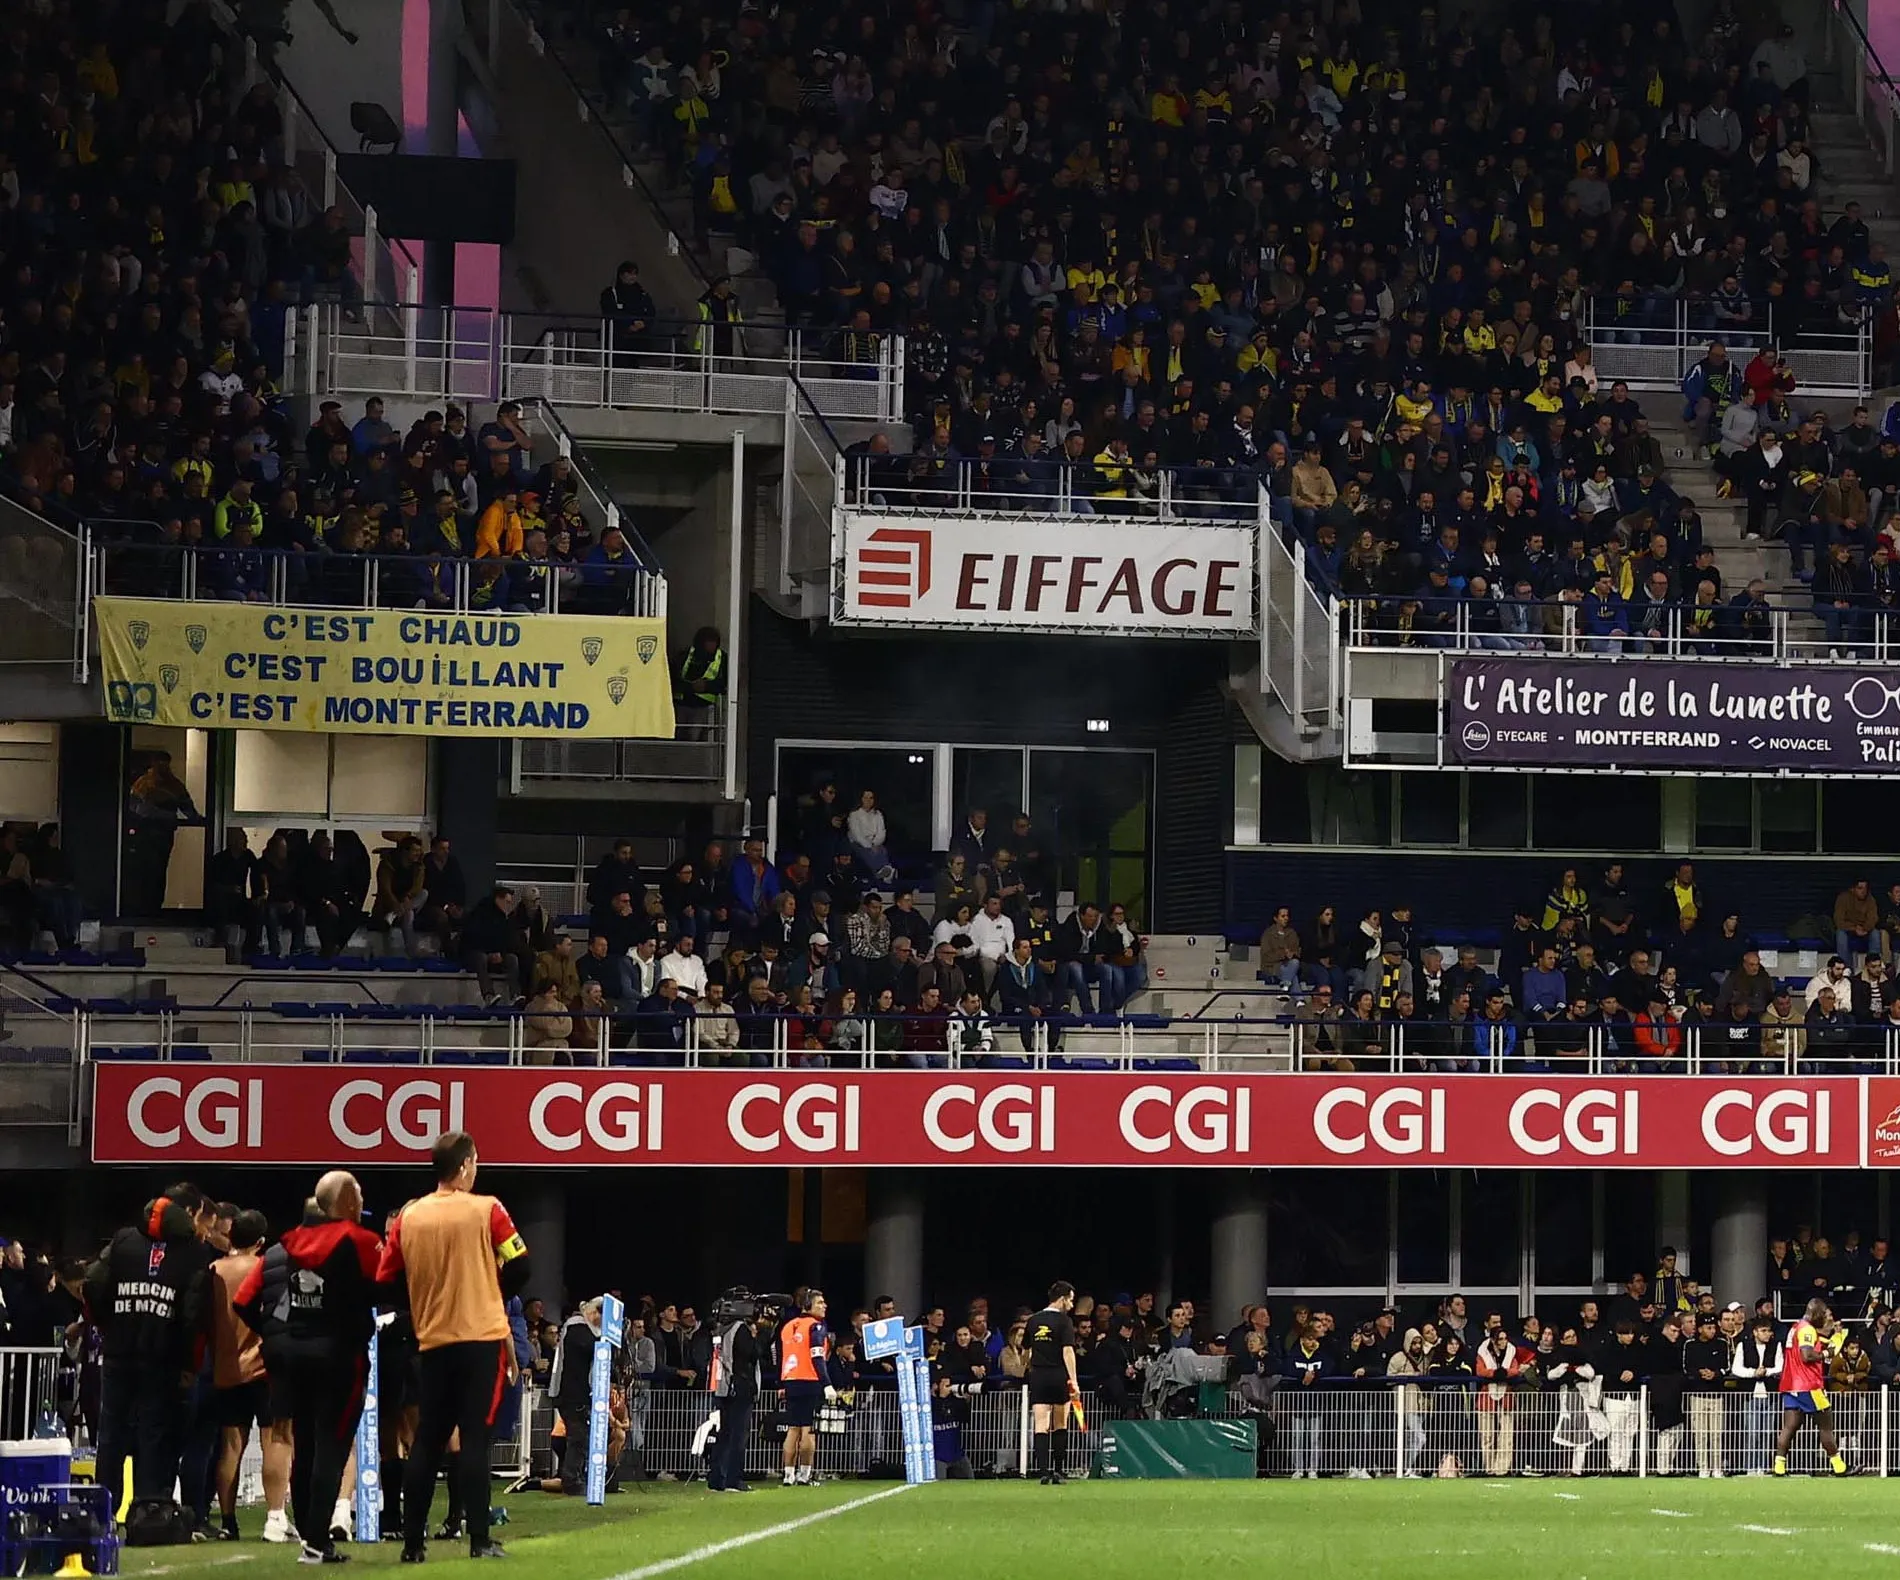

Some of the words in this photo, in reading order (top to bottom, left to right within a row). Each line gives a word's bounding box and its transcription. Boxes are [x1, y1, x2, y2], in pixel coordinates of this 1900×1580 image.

[955, 553, 1240, 617] EIFFAGE
[263, 613, 374, 642] C'EST
[399, 616, 521, 647] CHAUD
[224, 652, 327, 682] C'EST
[190, 691, 297, 722] C'EST
[325, 696, 590, 730] MONTFERRAND
[1463, 676, 1486, 712] L'
[1497, 678, 1608, 719] Atelier
[1618, 682, 1655, 719] de
[1667, 682, 1699, 719] la
[1709, 683, 1833, 723] Lunette
[1496, 729, 1548, 743] EYECARE
[1575, 729, 1720, 749] MONTFERRAND
[1769, 737, 1832, 752] NOVACEL
[126, 1076, 263, 1148] CGI
[328, 1079, 465, 1150] CGI
[529, 1081, 663, 1152] CGI
[726, 1083, 860, 1153] CGI
[922, 1084, 1056, 1153] CGI
[1118, 1085, 1251, 1153] CGI
[1312, 1085, 1445, 1154] CGI
[1508, 1088, 1639, 1156] CGI
[1700, 1089, 1830, 1156] CGI
[114, 1300, 132, 1313] DE
[365, 1427, 377, 1465] Région
[366, 1503, 379, 1541] Région
